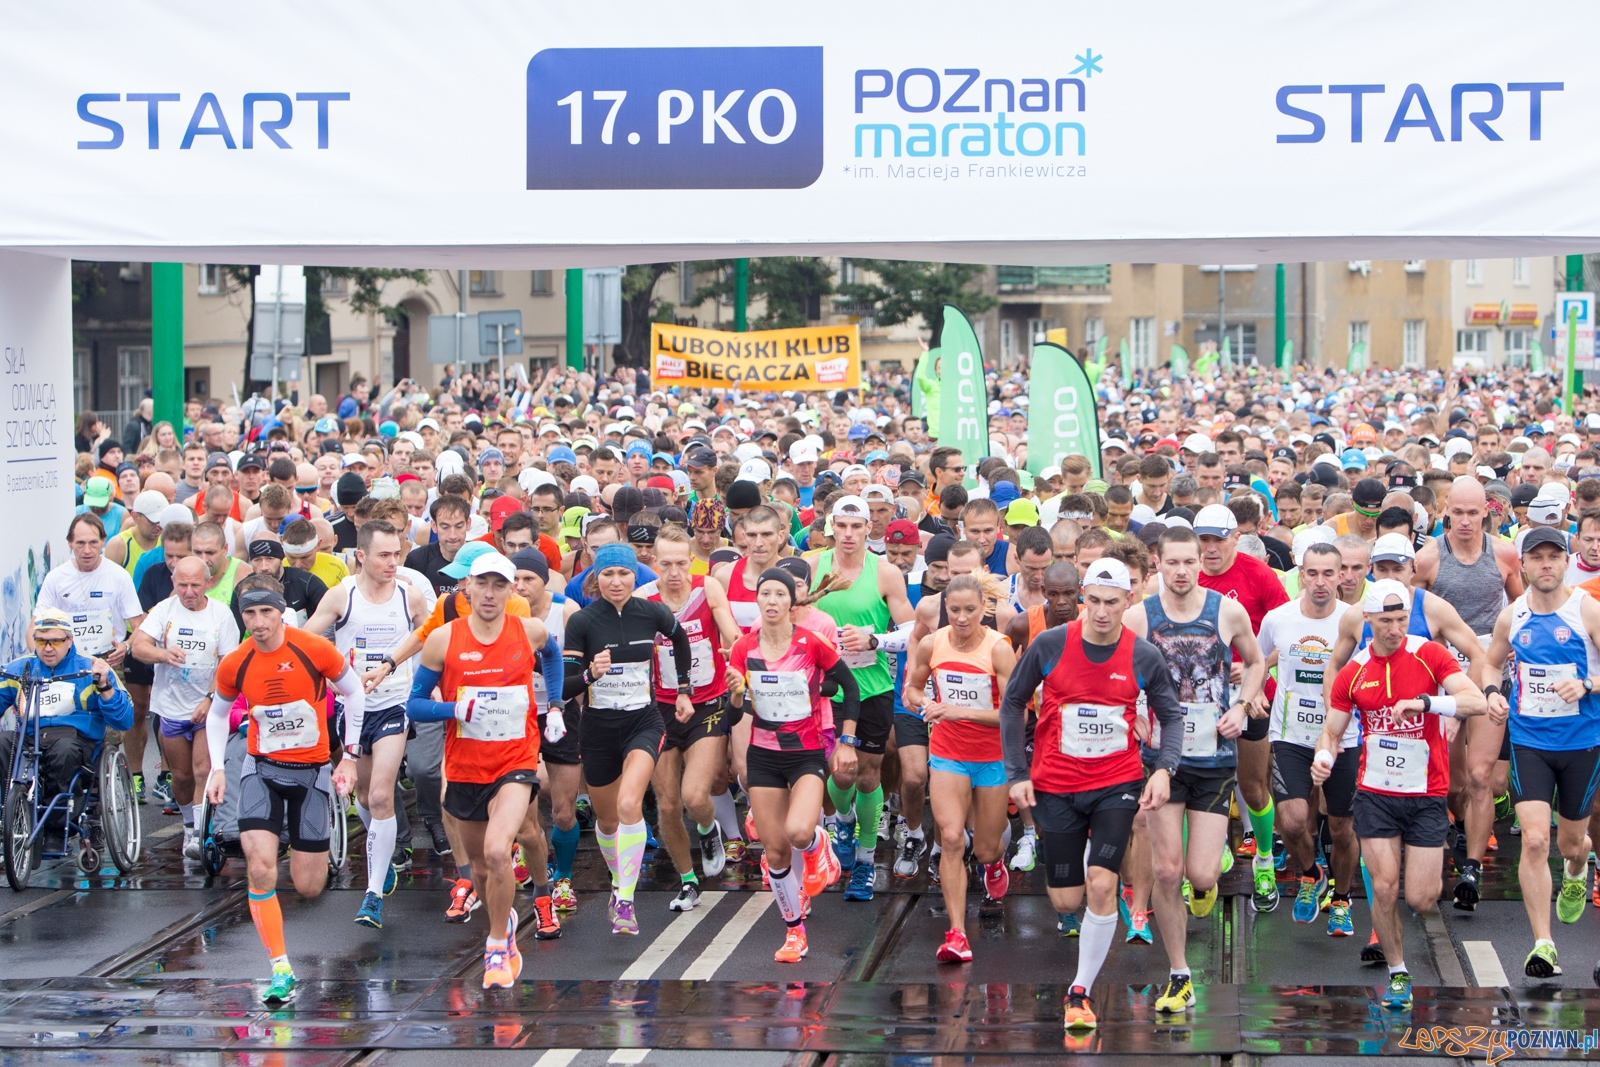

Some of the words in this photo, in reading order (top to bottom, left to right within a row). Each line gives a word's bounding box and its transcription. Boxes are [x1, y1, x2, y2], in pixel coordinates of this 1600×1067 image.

[1276, 82, 1565, 144] START
[76, 92, 351, 150] START
[854, 112, 1086, 158] maraton
[888, 164, 960, 181] Macieja
[968, 163, 1087, 178] Frankiewicza
[658, 334, 778, 359] LUBOŃSKI
[786, 335, 850, 357] KLUB
[5, 347, 27, 374] SIŁA
[686, 360, 811, 382] BIEGACZA
[12, 383, 57, 411] ODWAGA
[6, 413, 57, 448] SZYBKOŚĆ
[73, 625, 103, 637] 5742
[177, 640, 206, 651] 3379
[755, 689, 805, 697] Parszczyńska
[948, 688, 978, 700] 2190
[1528, 682, 1556, 694] 564
[487, 706, 510, 715] ehlau
[1297, 712, 1326, 724] 609
[268, 718, 305, 733] 2832
[1079, 723, 1114, 734] 5915
[1385, 756, 1406, 769] 82
